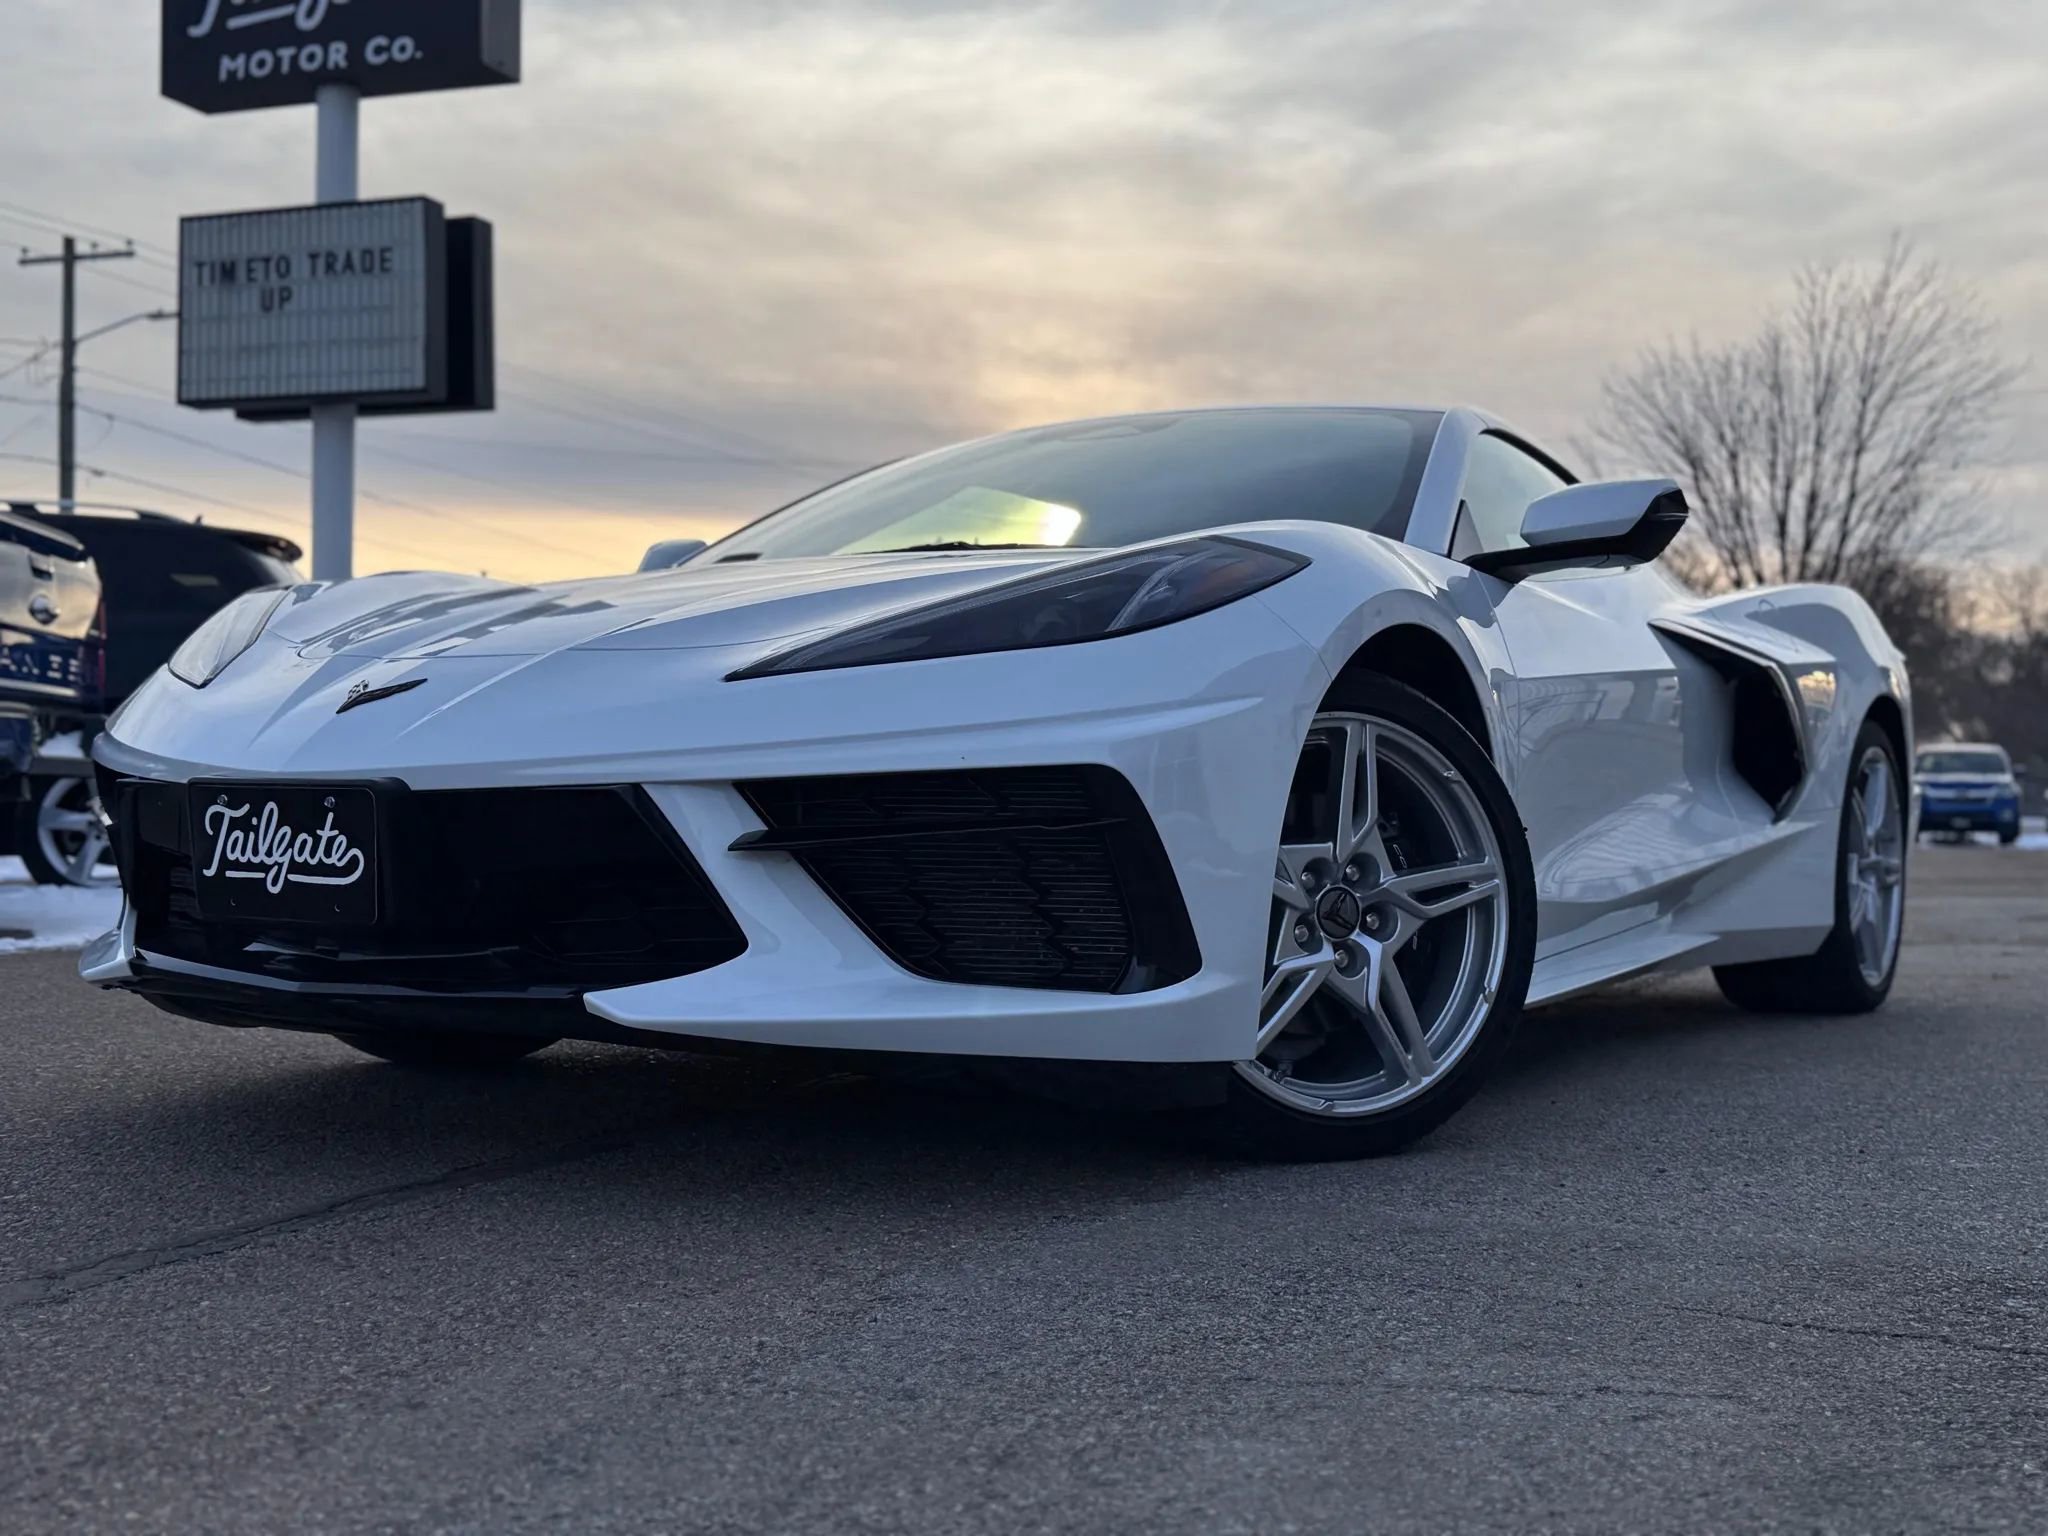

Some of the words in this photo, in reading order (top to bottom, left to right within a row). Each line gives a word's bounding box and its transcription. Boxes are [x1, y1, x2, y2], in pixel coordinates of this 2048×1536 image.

[218, 41, 348, 82] MOTOR
[363, 36, 423, 65] CO.
[307, 246, 393, 278] TRADE
[260, 285, 293, 312] UP
[203, 801, 365, 894] Tailgate
